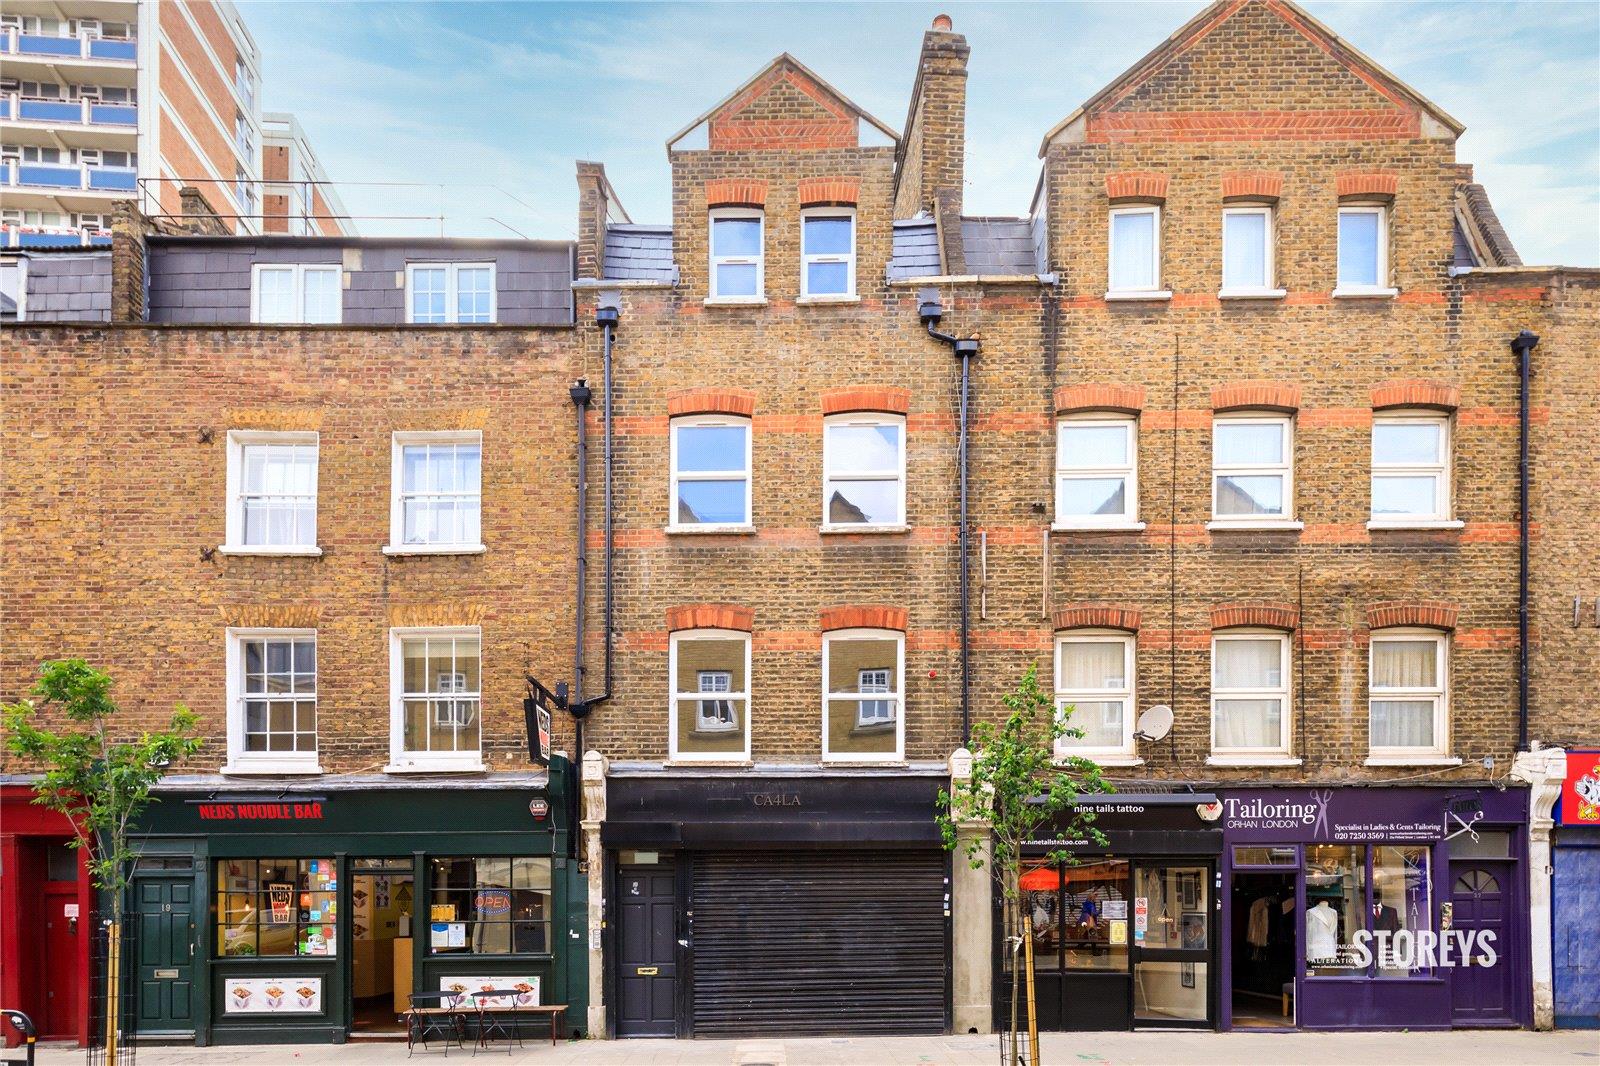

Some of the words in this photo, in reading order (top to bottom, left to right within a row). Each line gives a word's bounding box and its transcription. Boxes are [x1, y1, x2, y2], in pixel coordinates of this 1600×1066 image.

[753, 794, 801, 806] CA4LA
[199, 804, 235, 819] NEDS
[237, 804, 291, 819] NOODLE
[294, 803, 322, 819] BAR
[1073, 804, 1094, 813] nine
[1096, 804, 1115, 813] tails
[1116, 804, 1144, 813] tattoo
[1224, 798, 1317, 824] Tailoring
[1227, 820, 1257, 829] ORHAN
[1261, 820, 1299, 829] LONDON
[1334, 823, 1362, 832] Specialist
[1414, 823, 1441, 832] Tailoring
[1334, 832, 1348, 840] 020
[1349, 832, 1366, 840] 7250
[1367, 832, 1384, 840] 3569
[475, 896, 511, 908] OPEN
[161, 904, 171, 912] 19
